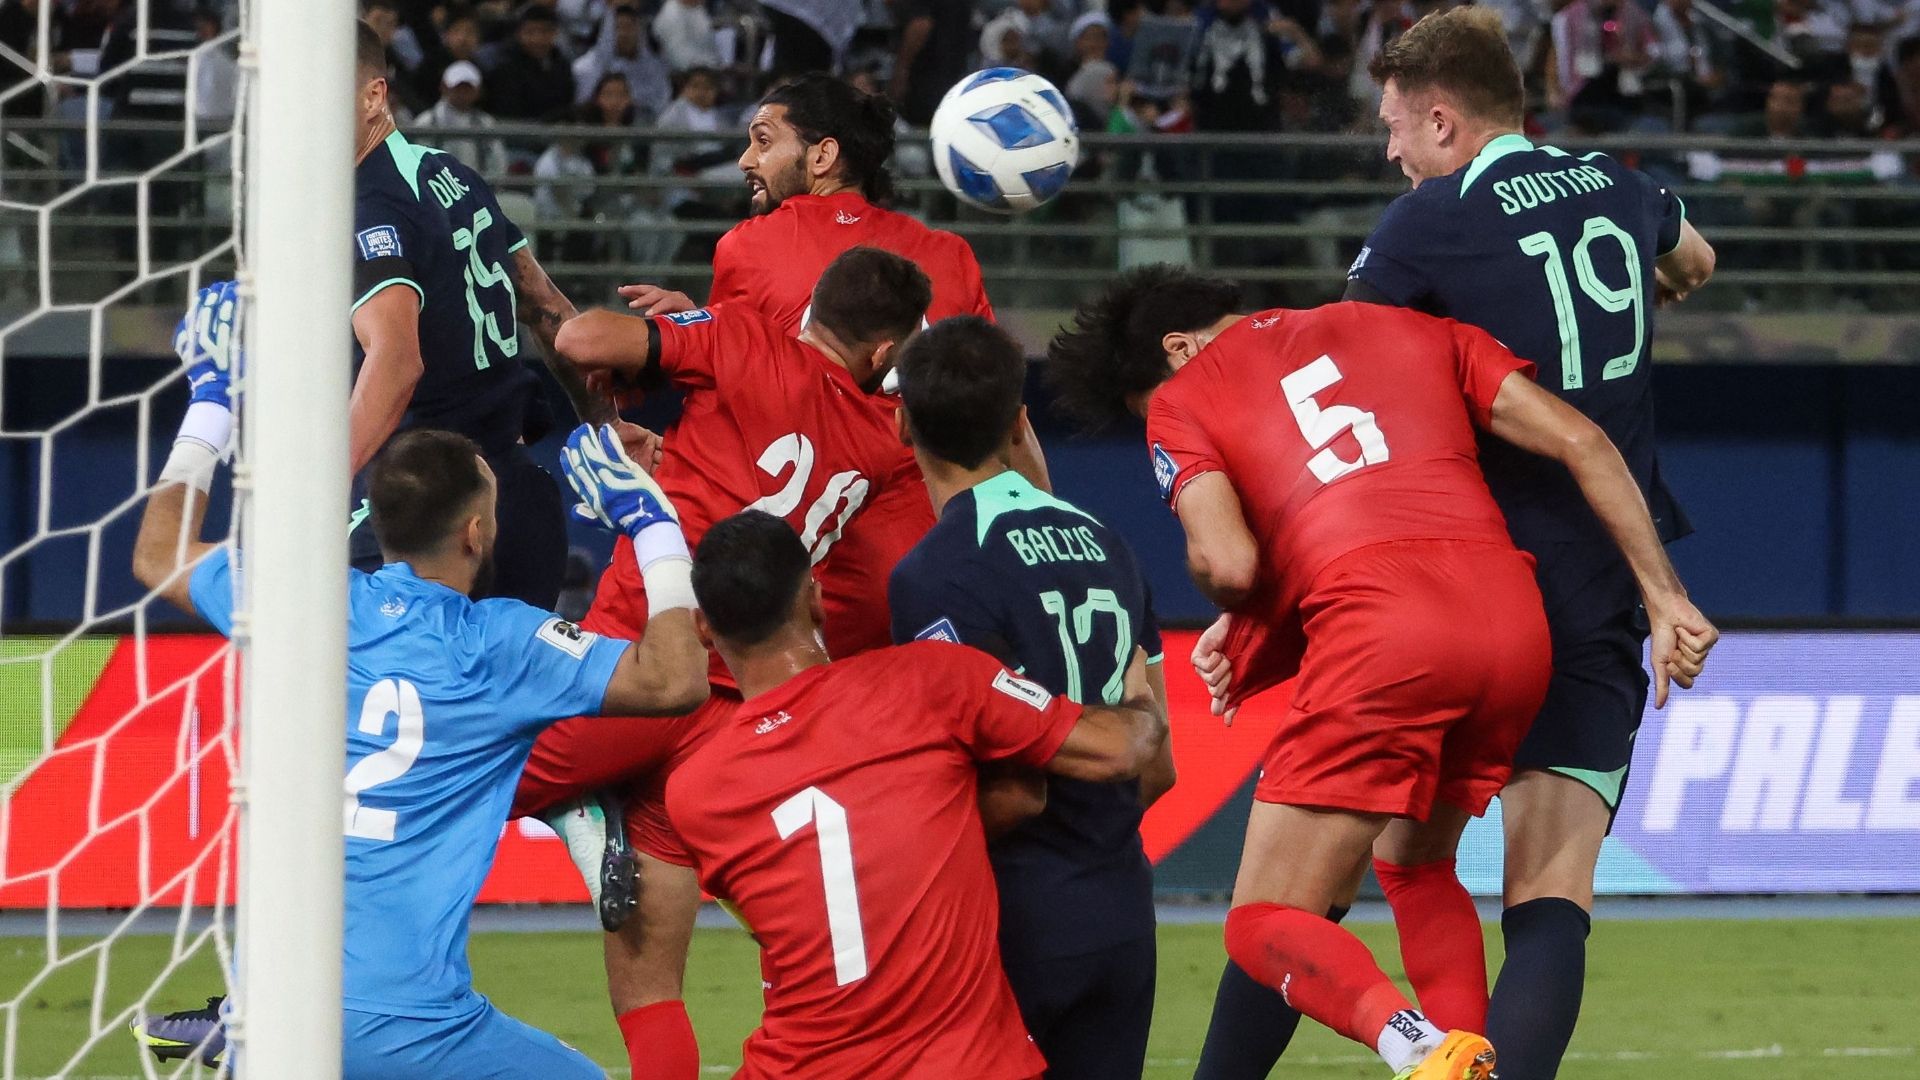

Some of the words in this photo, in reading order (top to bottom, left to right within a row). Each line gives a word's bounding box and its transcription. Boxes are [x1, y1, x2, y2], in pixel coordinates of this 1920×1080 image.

[1493, 165, 1614, 215] SOUTTAR
[452, 207, 518, 371] 15
[1517, 216, 1644, 390] 19
[1280, 354, 1389, 484] 5
[741, 432, 870, 567] 20
[1039, 588, 1132, 705] 17
[1641, 695, 1920, 832] PALE
[1386, 1012, 1429, 1043] DESIGN
